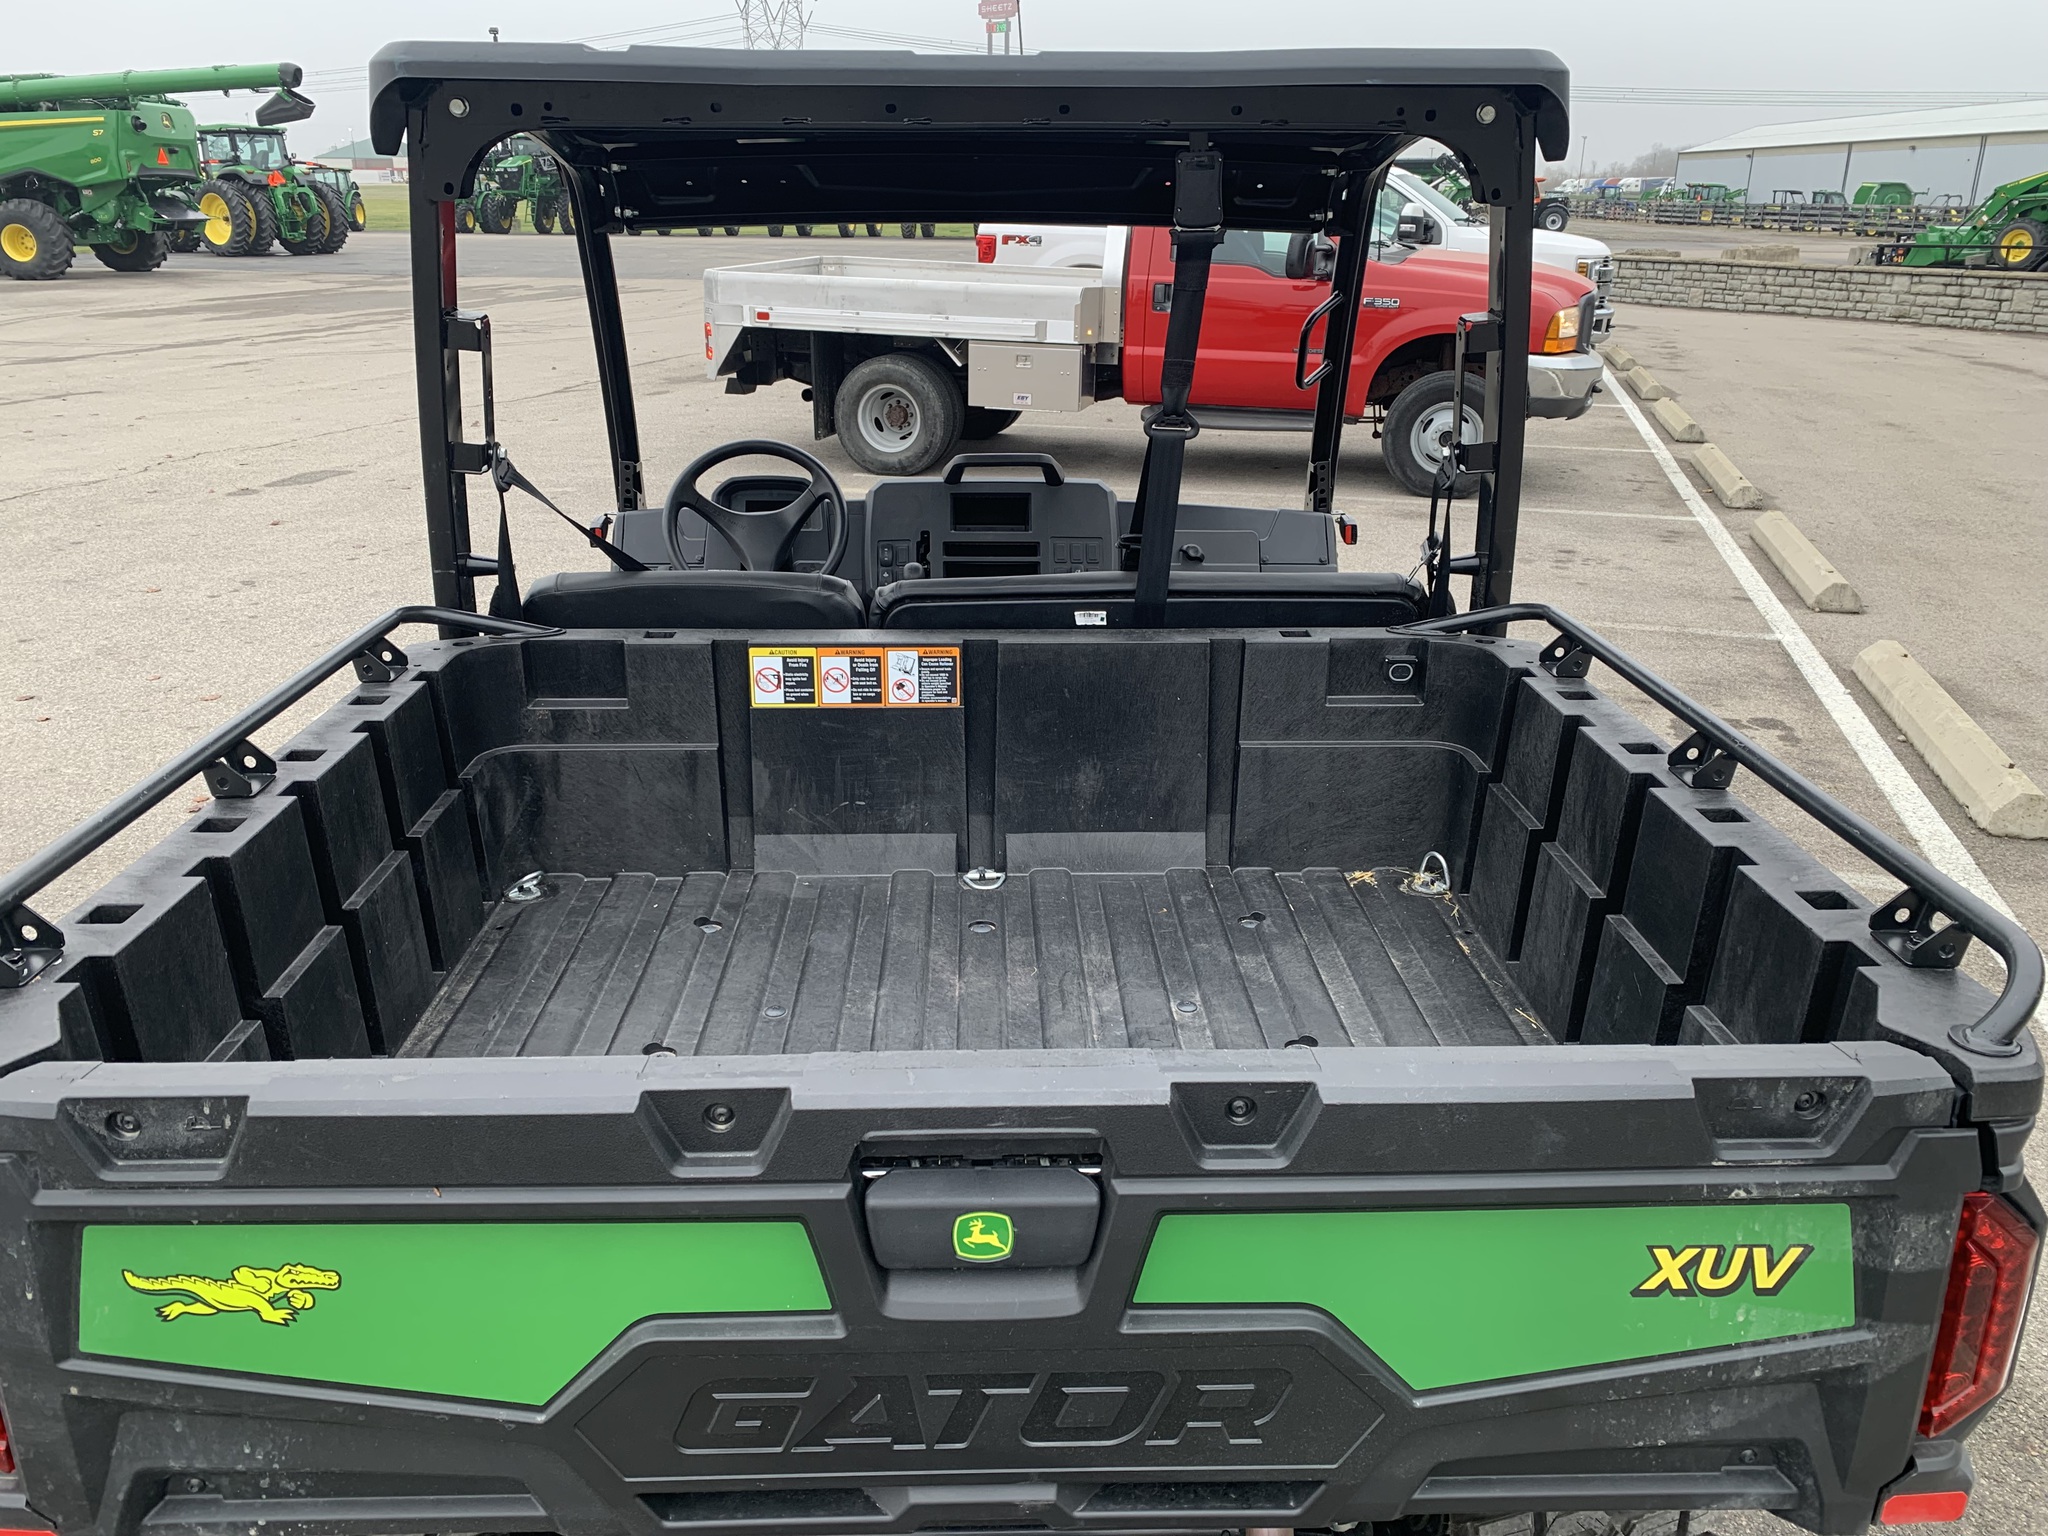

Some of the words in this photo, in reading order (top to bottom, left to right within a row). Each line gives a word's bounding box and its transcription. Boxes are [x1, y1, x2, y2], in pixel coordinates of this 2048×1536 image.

[981, 3, 1012, 12] SHEETZ
[1002, 234, 1042, 245] FX4
[1630, 1244, 1815, 1297] XUV
[673, 1367, 1293, 1454] GATOR
